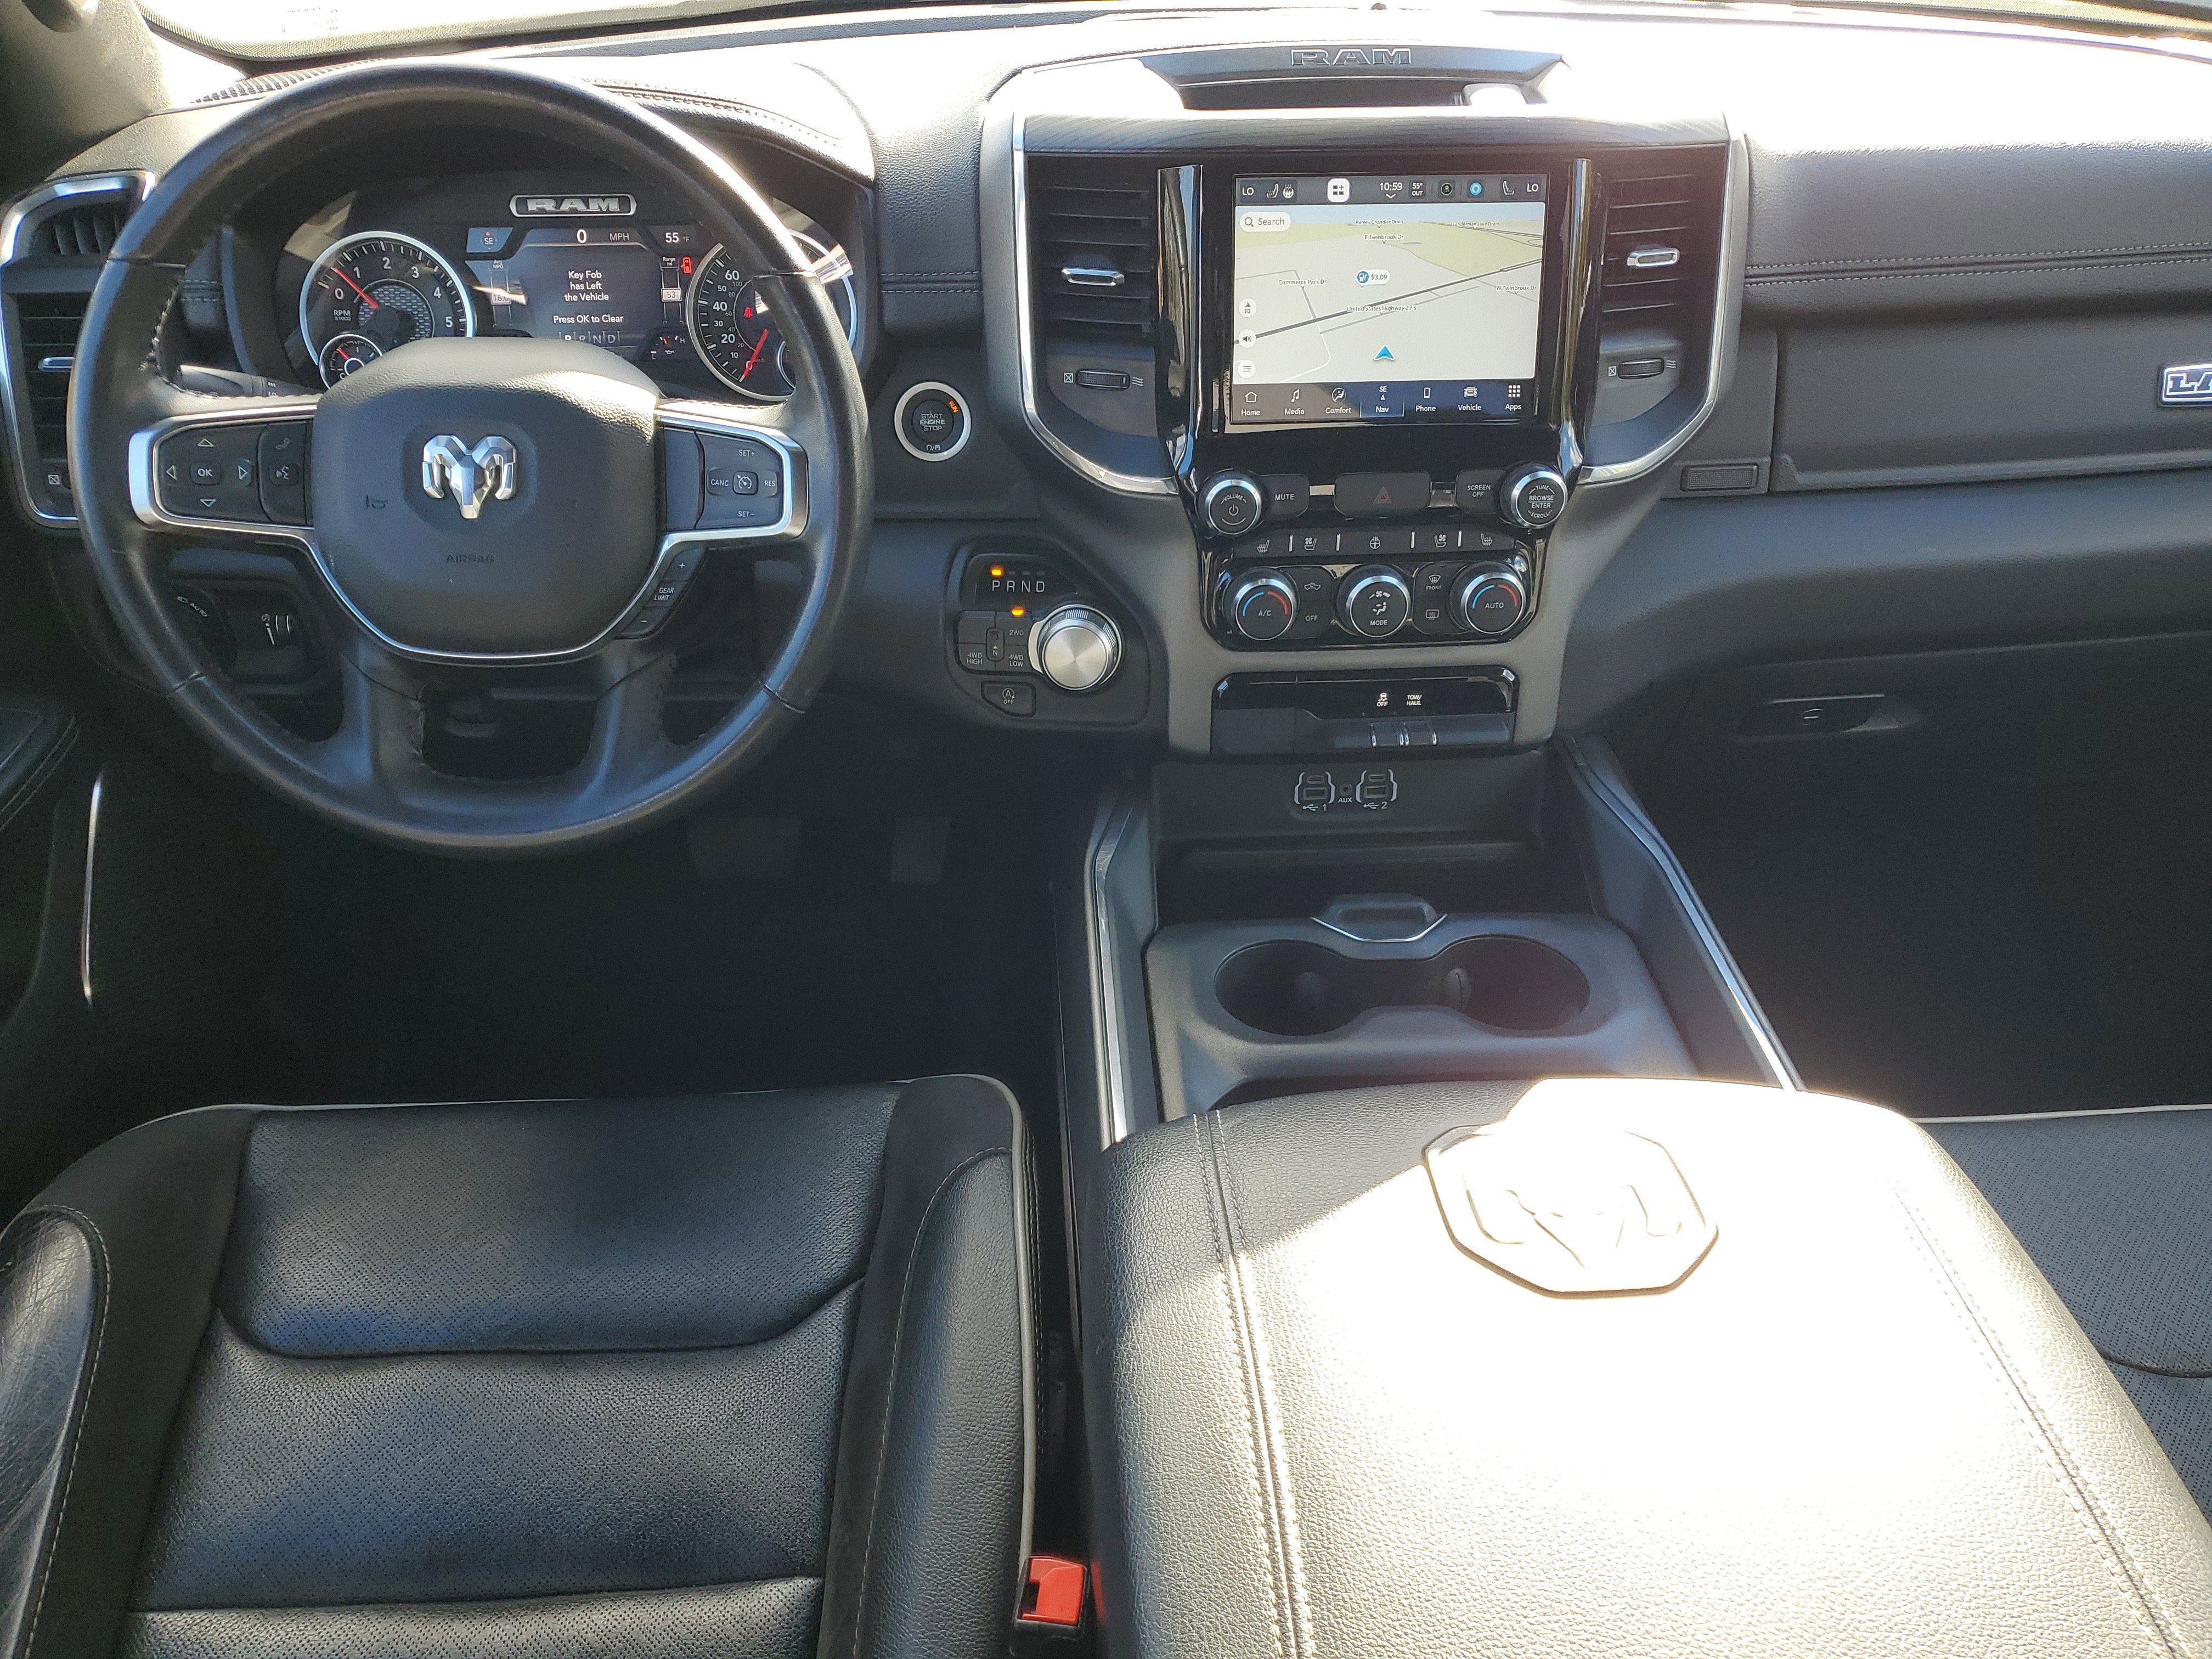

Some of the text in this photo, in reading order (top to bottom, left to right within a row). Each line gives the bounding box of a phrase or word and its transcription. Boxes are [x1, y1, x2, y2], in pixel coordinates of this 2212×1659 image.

[1291, 48, 1412, 65] RAM
[1242, 187, 1254, 196] LO
[1380, 182, 1403, 191] 10:59
[1527, 183, 1539, 192] LO
[527, 198, 620, 212] RAM
[1258, 217, 1285, 225] Search
[577, 229, 629, 243] 0 MPH
[665, 232, 679, 242] 55
[382, 257, 392, 269] 2
[353, 267, 361, 279] 1
[411, 266, 420, 278] 3
[568, 270, 602, 280] Key Fob
[725, 270, 740, 280] 60
[570, 281, 602, 290] has Left
[335, 288, 344, 300] 0
[433, 286, 442, 298] 4
[564, 292, 609, 301] the Vehicle
[713, 301, 727, 311] 40
[445, 316, 453, 328] 5
[602, 314, 624, 322] Clear
[721, 334, 735, 343] 20
[949, 400, 959, 413] RUN
[198, 468, 213, 477] OK
[710, 478, 729, 487] CANC
[1223, 493, 1243, 501] VOLUME
[190, 603, 208, 617] AUTO
[1322, 803, 1326, 812] 1
